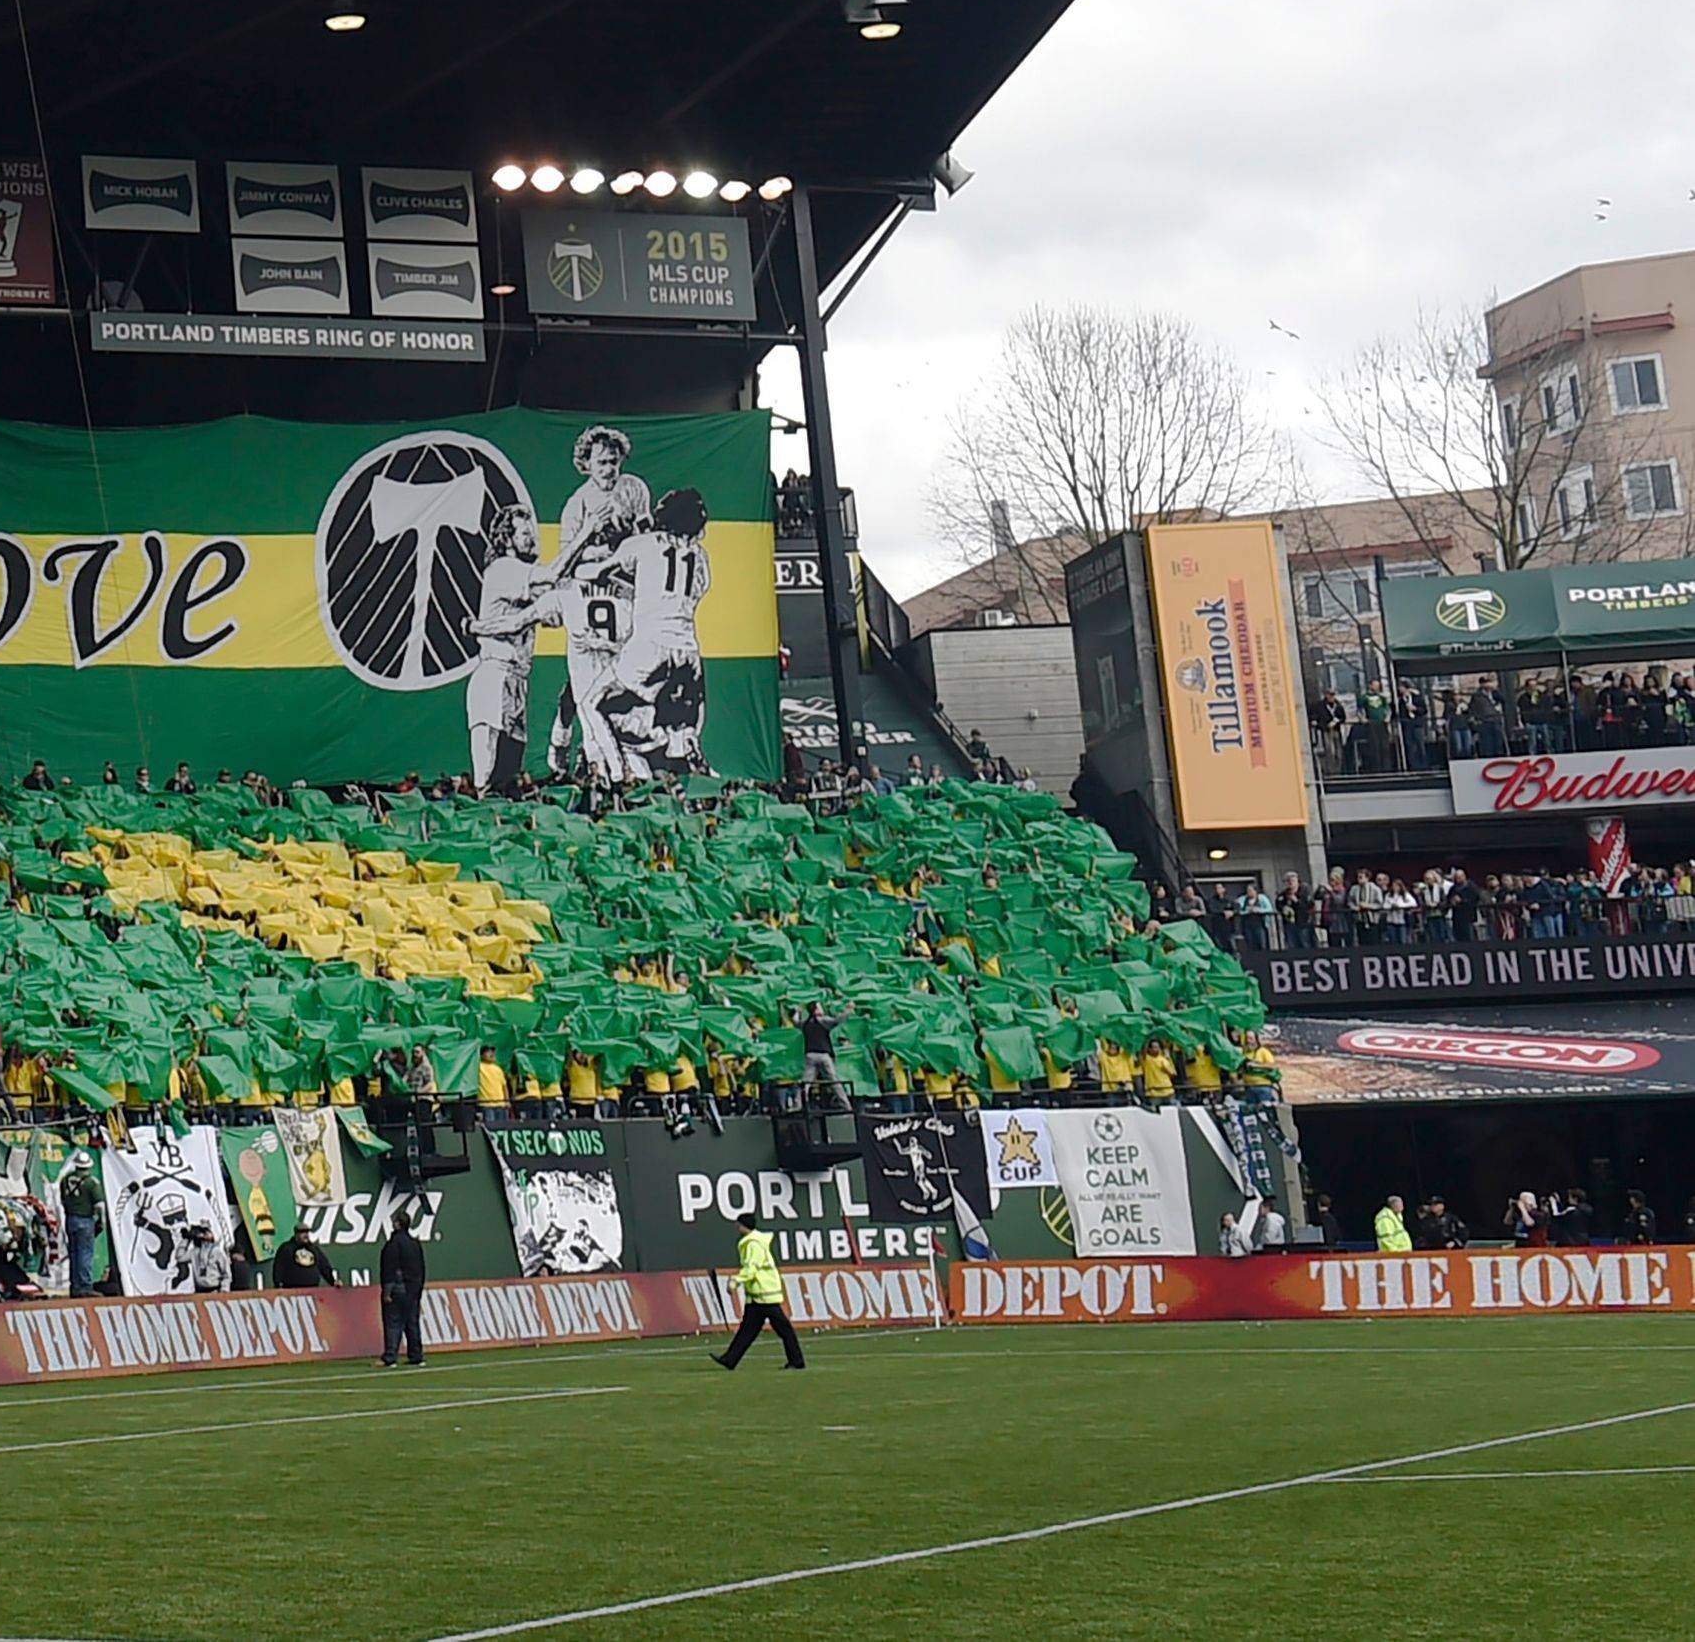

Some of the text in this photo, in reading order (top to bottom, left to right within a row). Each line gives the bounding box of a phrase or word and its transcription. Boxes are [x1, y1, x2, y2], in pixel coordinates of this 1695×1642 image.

[103, 184, 179, 200] MICK HOBAN
[238, 189, 330, 206] JIMMY CONWAY
[376, 195, 464, 212] CLIVE CHARLES
[646, 230, 729, 263] 2015
[259, 267, 324, 282] JOHN BAIN
[392, 271, 460, 287] TIMBER JIM
[648, 263, 730, 287] MLS CUP
[649, 286, 734, 307] CHAMPIONS
[101, 321, 475, 351] PORTLAND TIMBERS RING OF HONOR
[662, 546, 696, 597] 11
[1601, 596, 1690, 611] TIMBERS
[1195, 597, 1244, 755] Tillamook
[1233, 601, 1264, 749] MEDIUM CHEDDAR
[1271, 954, 1350, 995] BEST
[1362, 953, 1473, 989] BREAD
[1485, 952, 1528, 983] IN
[1529, 946, 1595, 982] THE
[1365, 1034, 1614, 1065] OREGON
[149, 1142, 181, 1168] YB
[1086, 1145, 1140, 1166] KEEP
[1000, 1166, 1042, 1182] CUP
[1086, 1167, 1149, 1189] CALM
[1100, 1204, 1144, 1225] ARE
[1088, 1227, 1161, 1247] GOALS
[1310, 1252, 1672, 1312] THE HOME
[781, 1269, 944, 1322] HOME
[453, 1283, 550, 1343] HOME
[5, 1306, 102, 1374] THE
[95, 1301, 211, 1367] HOME
